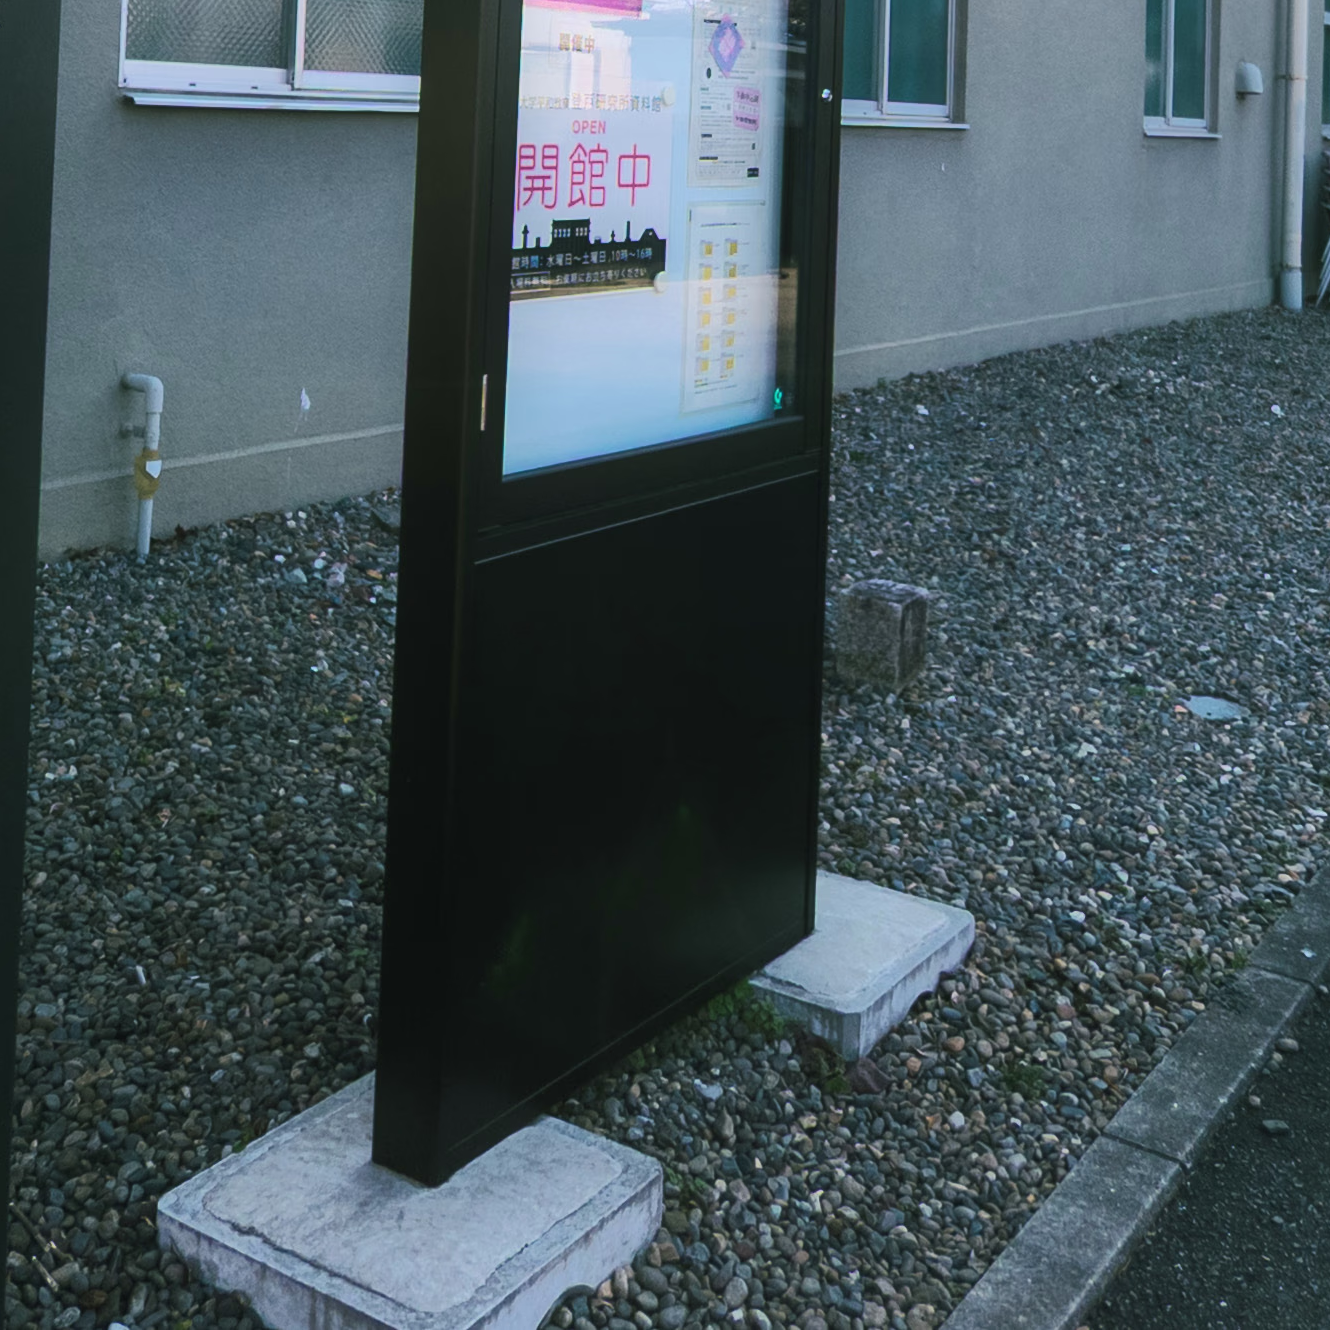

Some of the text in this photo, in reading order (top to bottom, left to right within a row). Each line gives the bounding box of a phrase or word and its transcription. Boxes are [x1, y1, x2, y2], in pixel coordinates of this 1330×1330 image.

[572, 120, 606, 134] OPEN
[517, 143, 652, 212] 開館中
